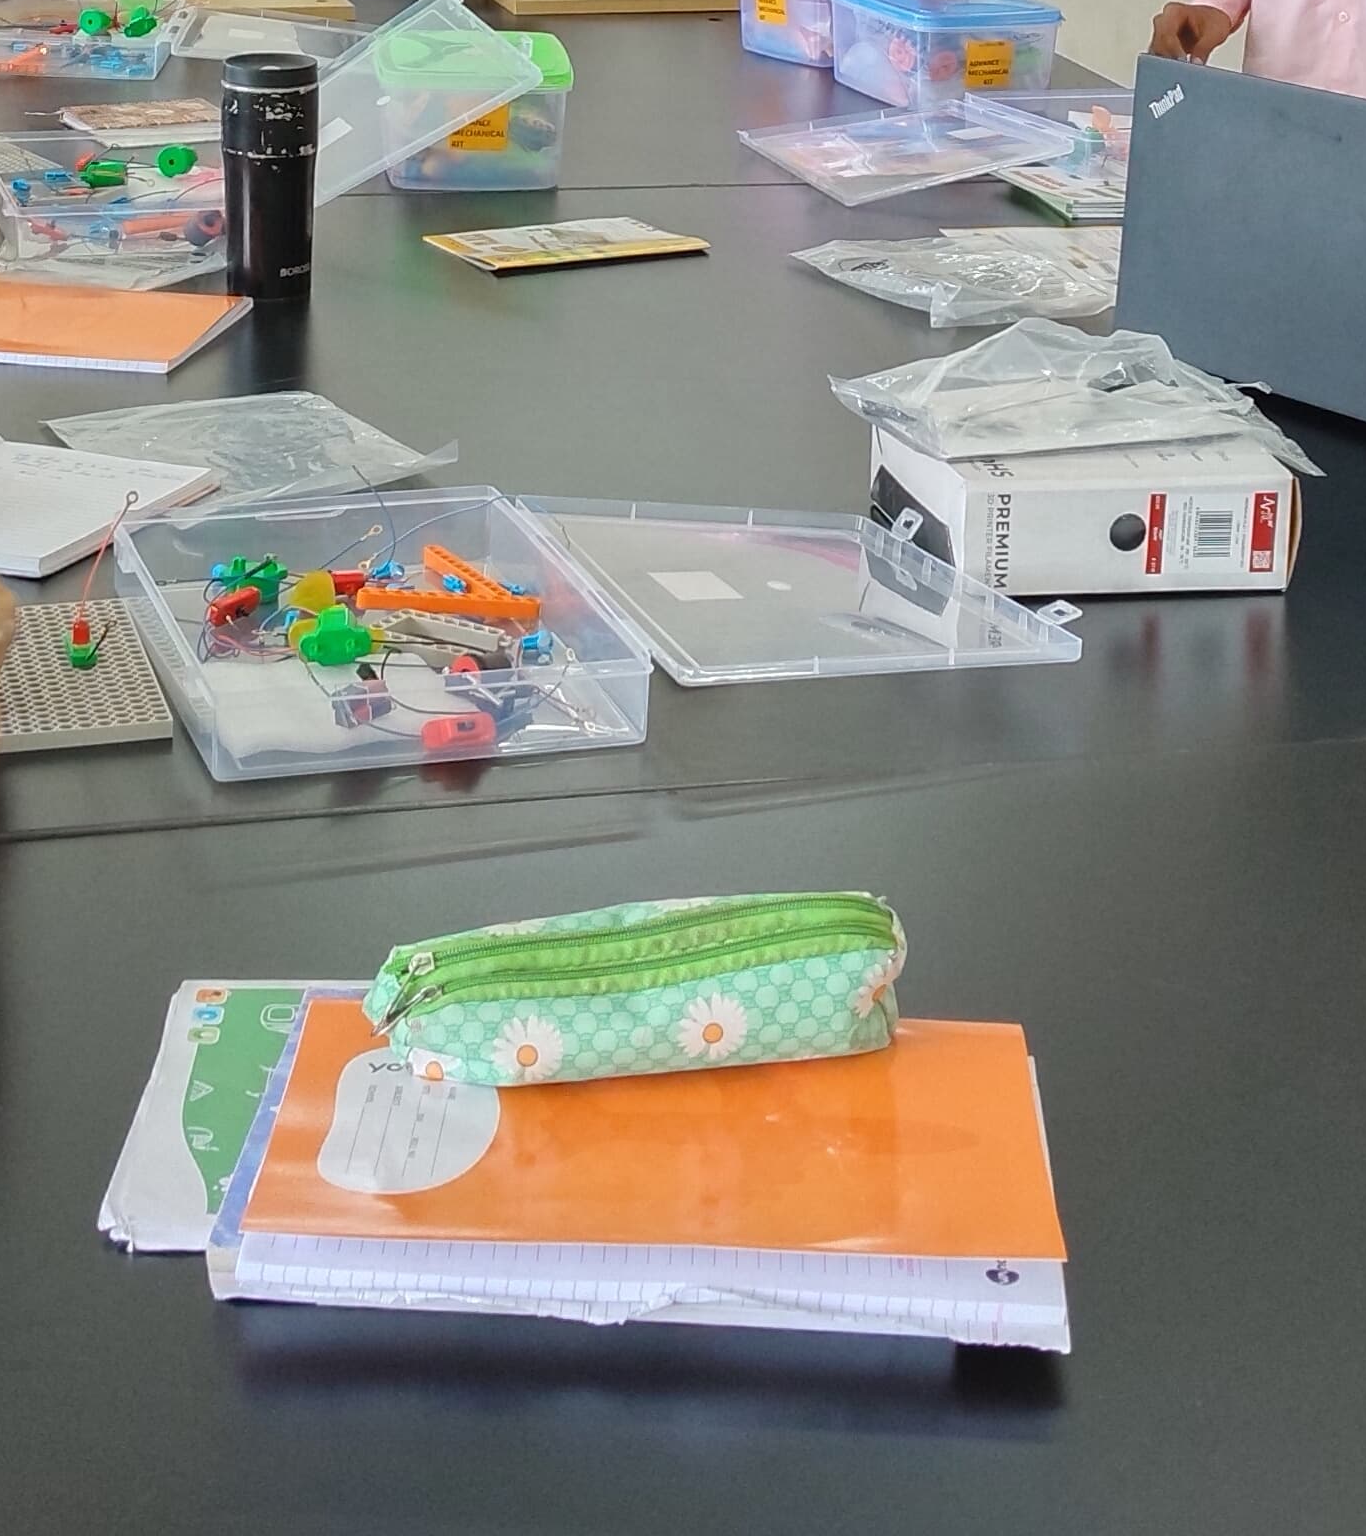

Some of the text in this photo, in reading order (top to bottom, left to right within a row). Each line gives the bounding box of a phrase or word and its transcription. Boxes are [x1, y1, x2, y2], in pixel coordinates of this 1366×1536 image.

[1148, 83, 1184, 119] ThinkPad
[986, 507, 994, 544] PRINTER
[993, 493, 1011, 589] PREMIUM
[985, 546, 993, 588] FILAMEN
